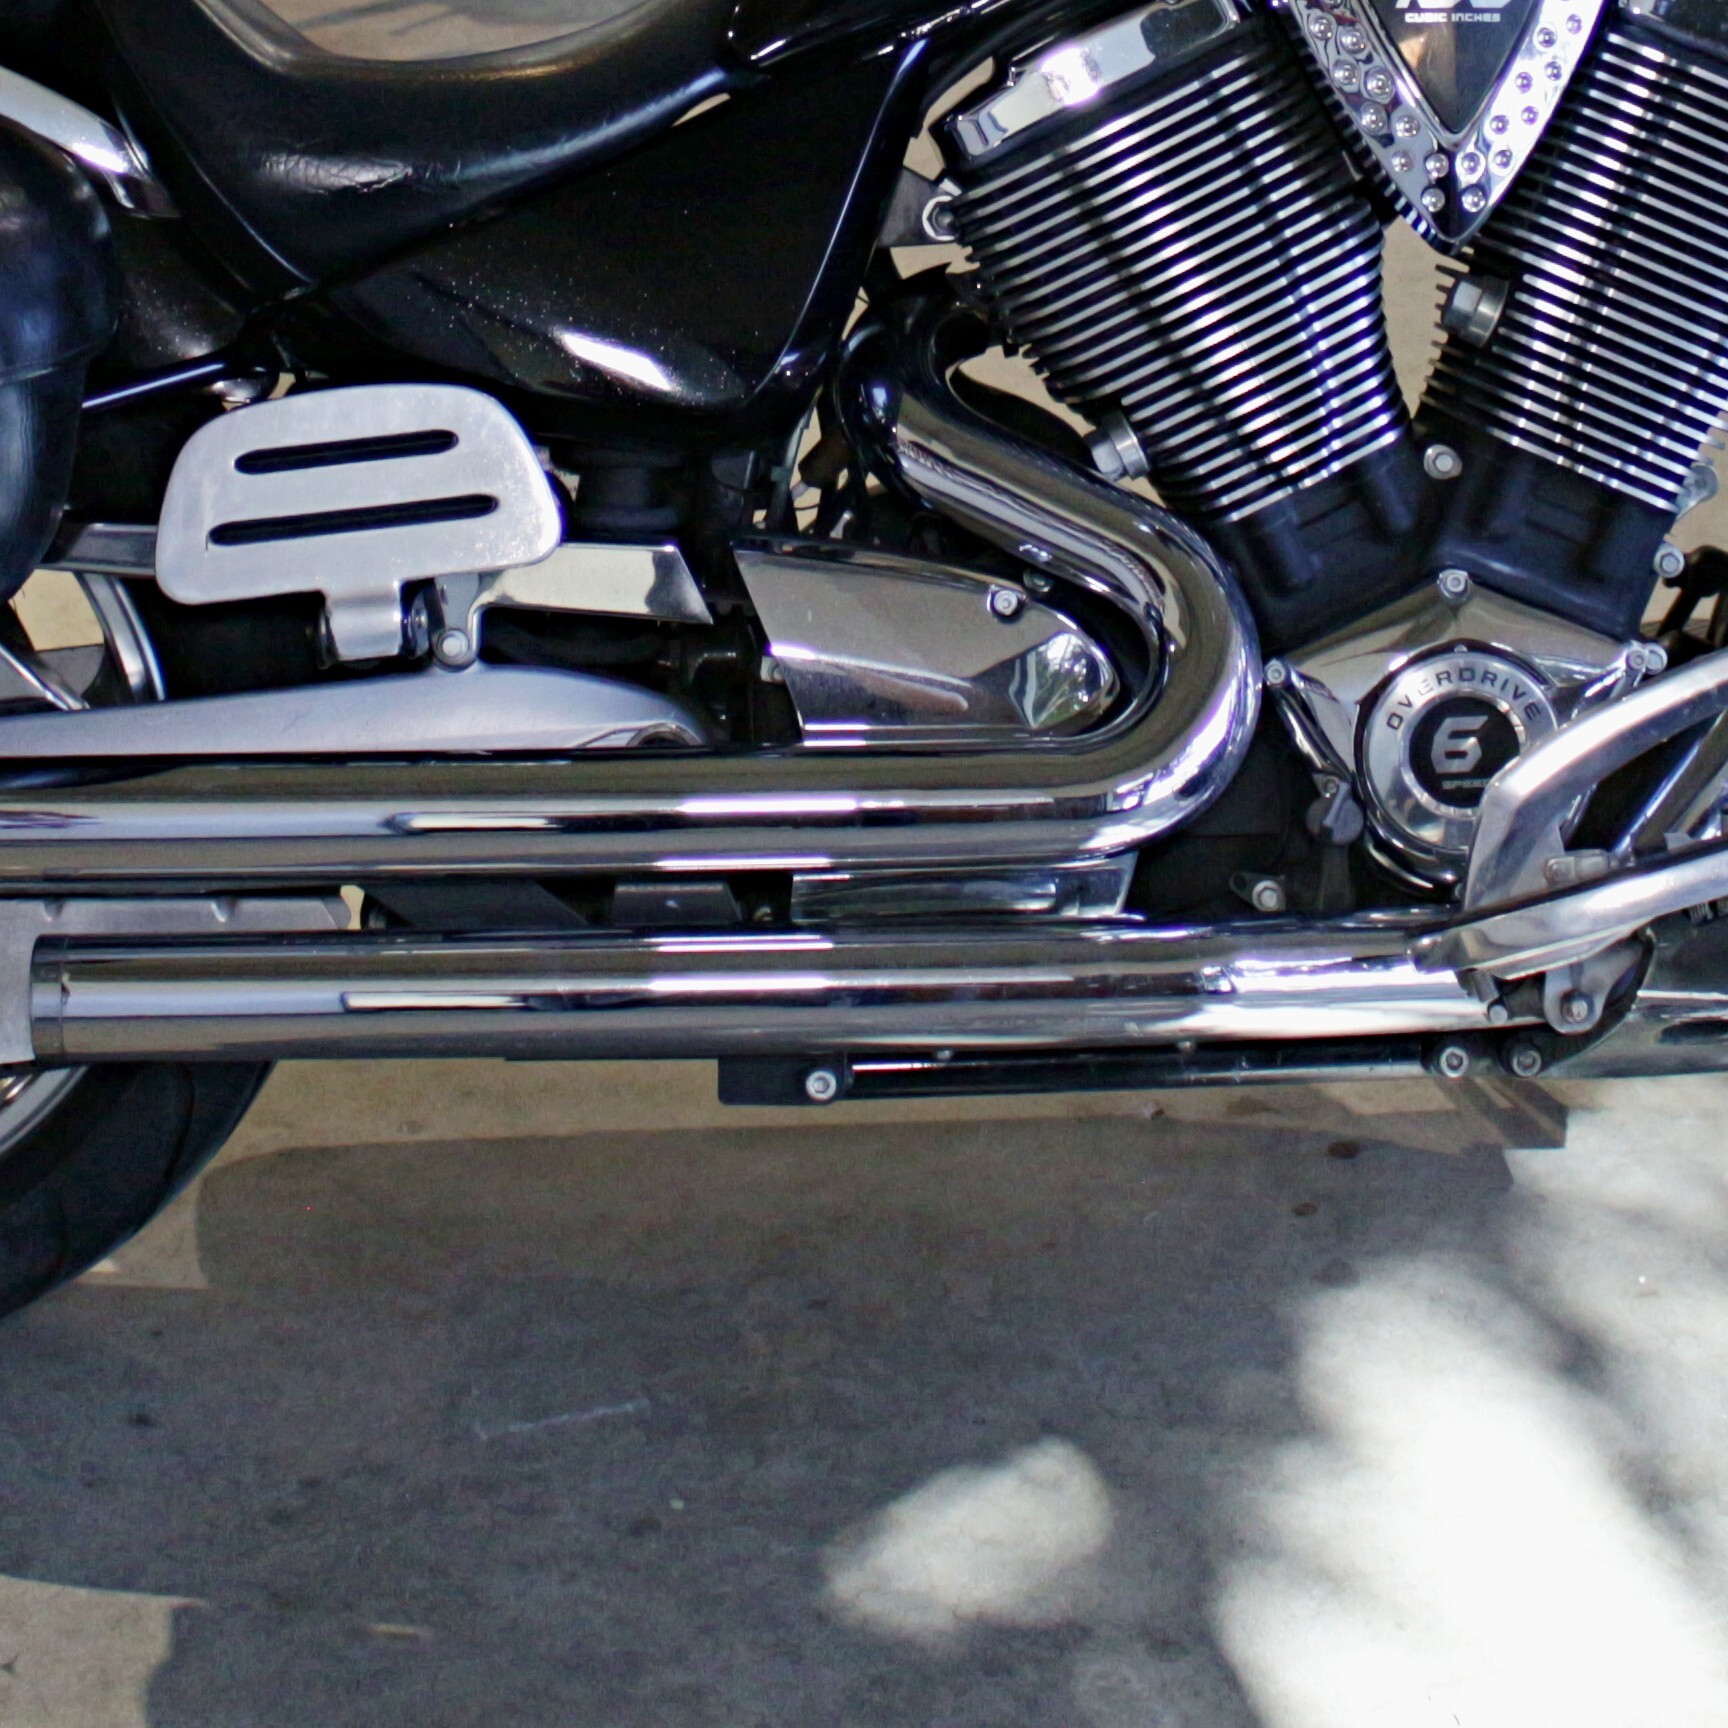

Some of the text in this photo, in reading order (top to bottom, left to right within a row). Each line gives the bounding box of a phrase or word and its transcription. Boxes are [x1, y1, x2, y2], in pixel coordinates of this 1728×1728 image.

[1405, 12, 1501, 23] CUBIC INCHES
[1386, 667, 1542, 730] OVERDRIVE
[1430, 714, 1489, 774] 6
